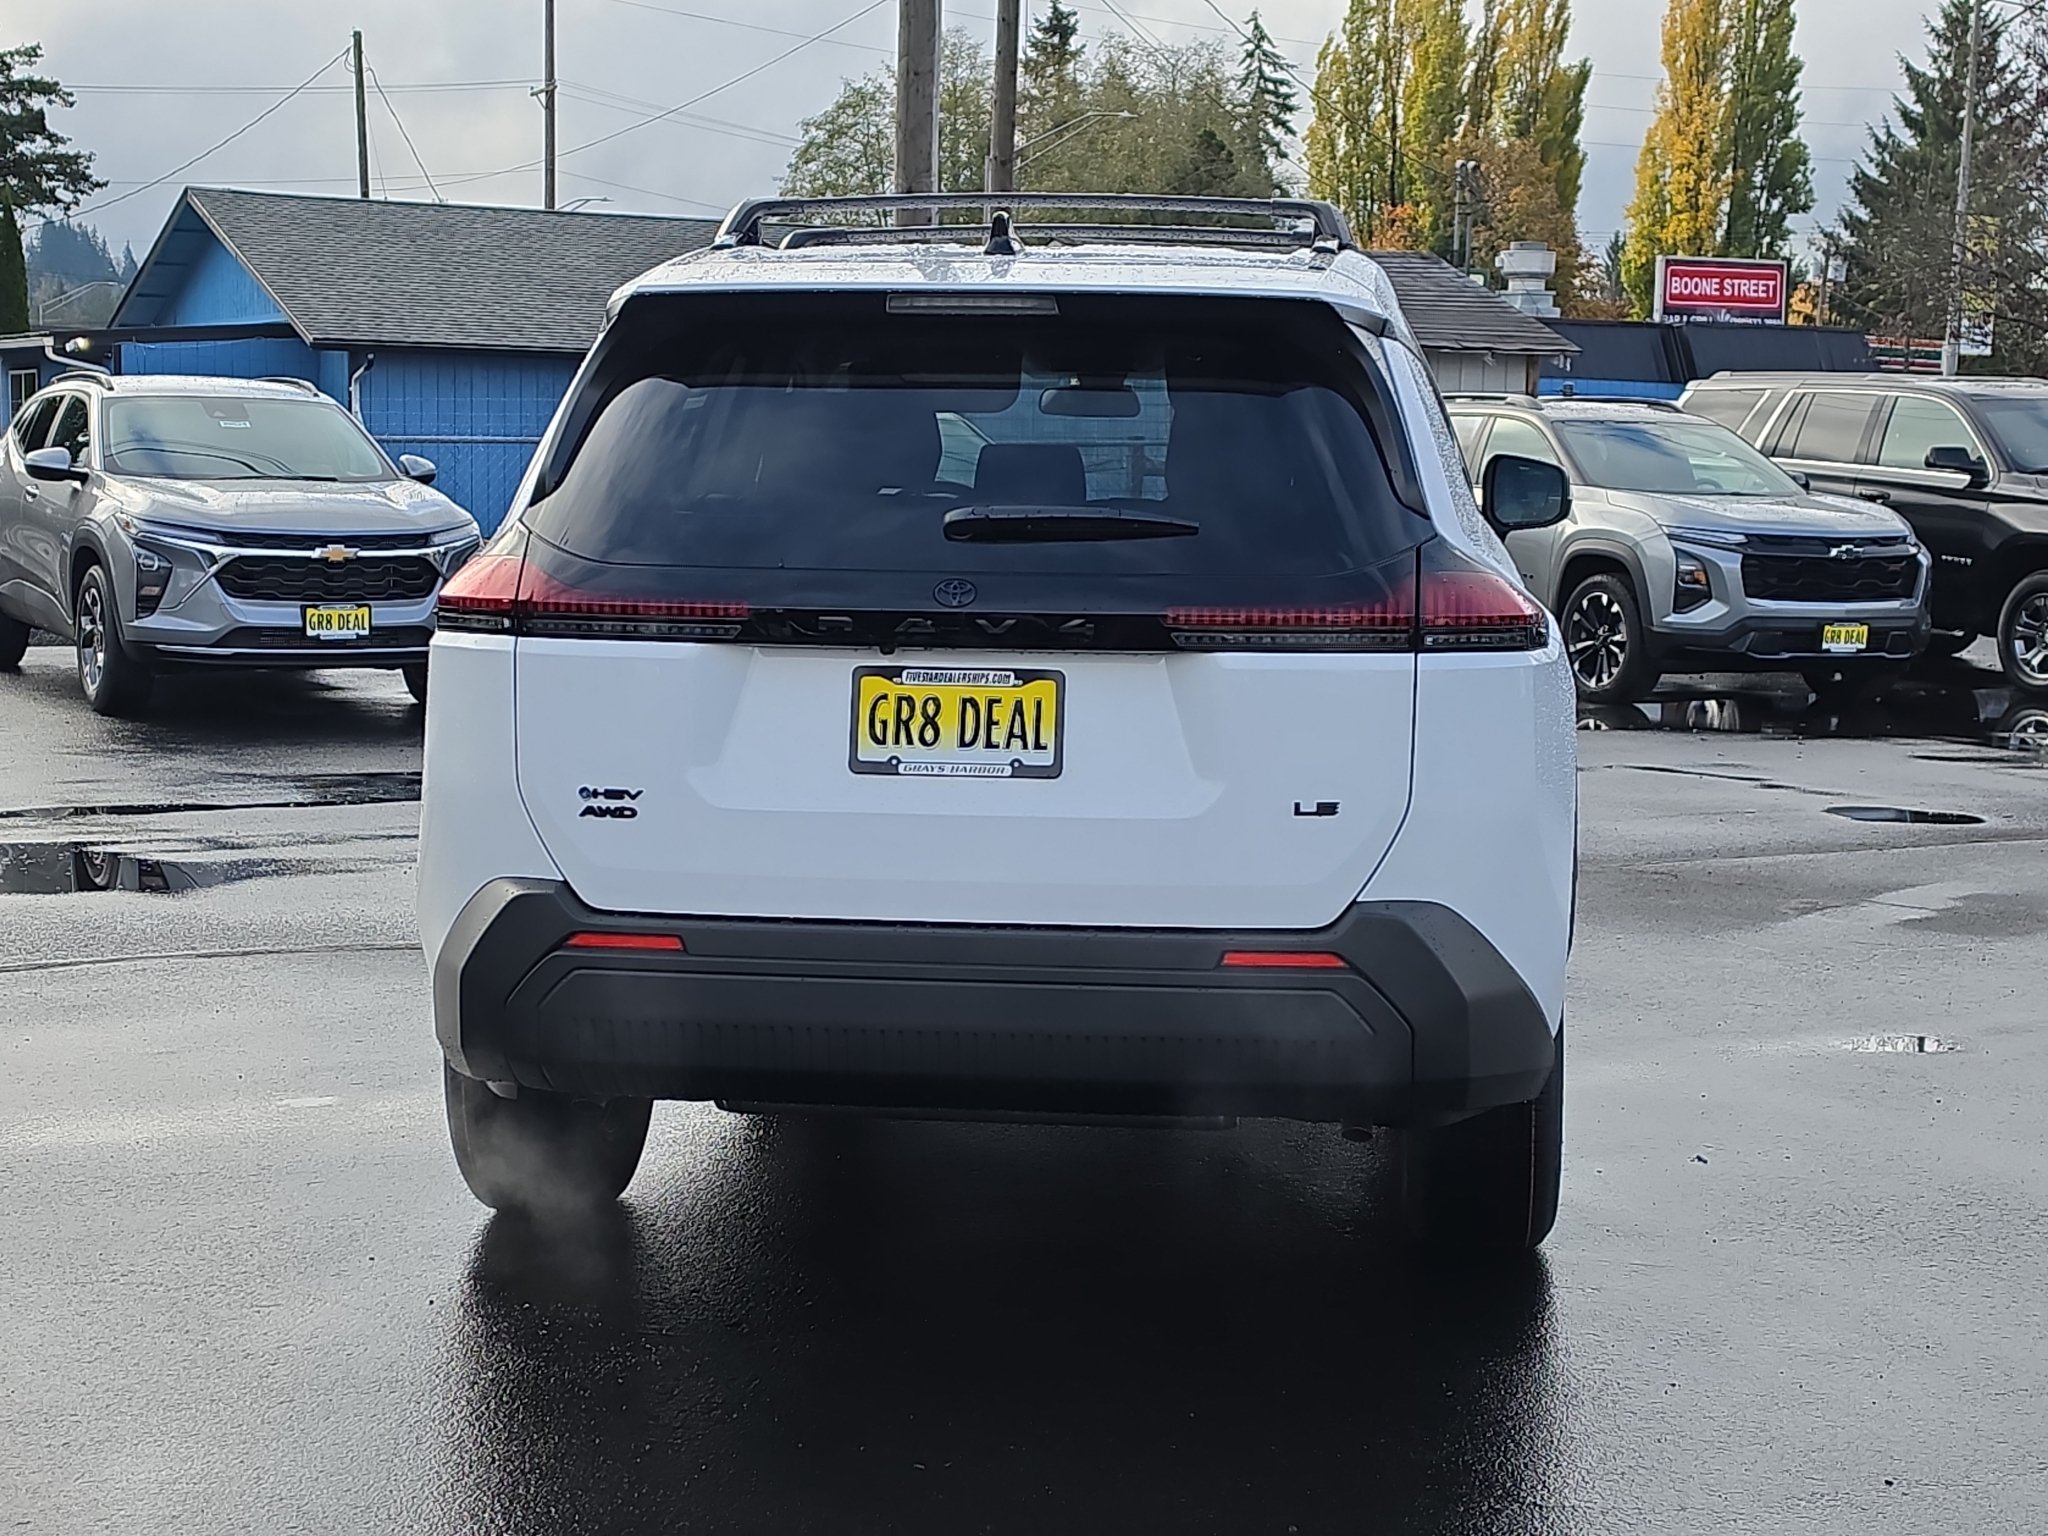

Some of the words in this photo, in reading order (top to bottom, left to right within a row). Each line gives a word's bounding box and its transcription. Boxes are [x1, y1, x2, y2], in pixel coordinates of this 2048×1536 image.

[1671, 277, 1720, 296] BOONE
[1723, 278, 1776, 298] STREET
[308, 612, 333, 631] GR8
[337, 612, 367, 631] DEAL
[817, 615, 1095, 637] RAV4
[1824, 628, 1842, 644] GR8
[1844, 629, 1865, 645] DEAL
[904, 671, 1012, 685] FIVESTARDEALERSHIPS.COM
[868, 693, 942, 748] GR8
[957, 695, 1049, 752] DEAL
[902, 764, 946, 774] GRAYS
[948, 765, 1007, 776] HARBOR
[591, 788, 644, 801] HEV
[578, 805, 638, 819] AWD
[1293, 801, 1341, 817] LE
